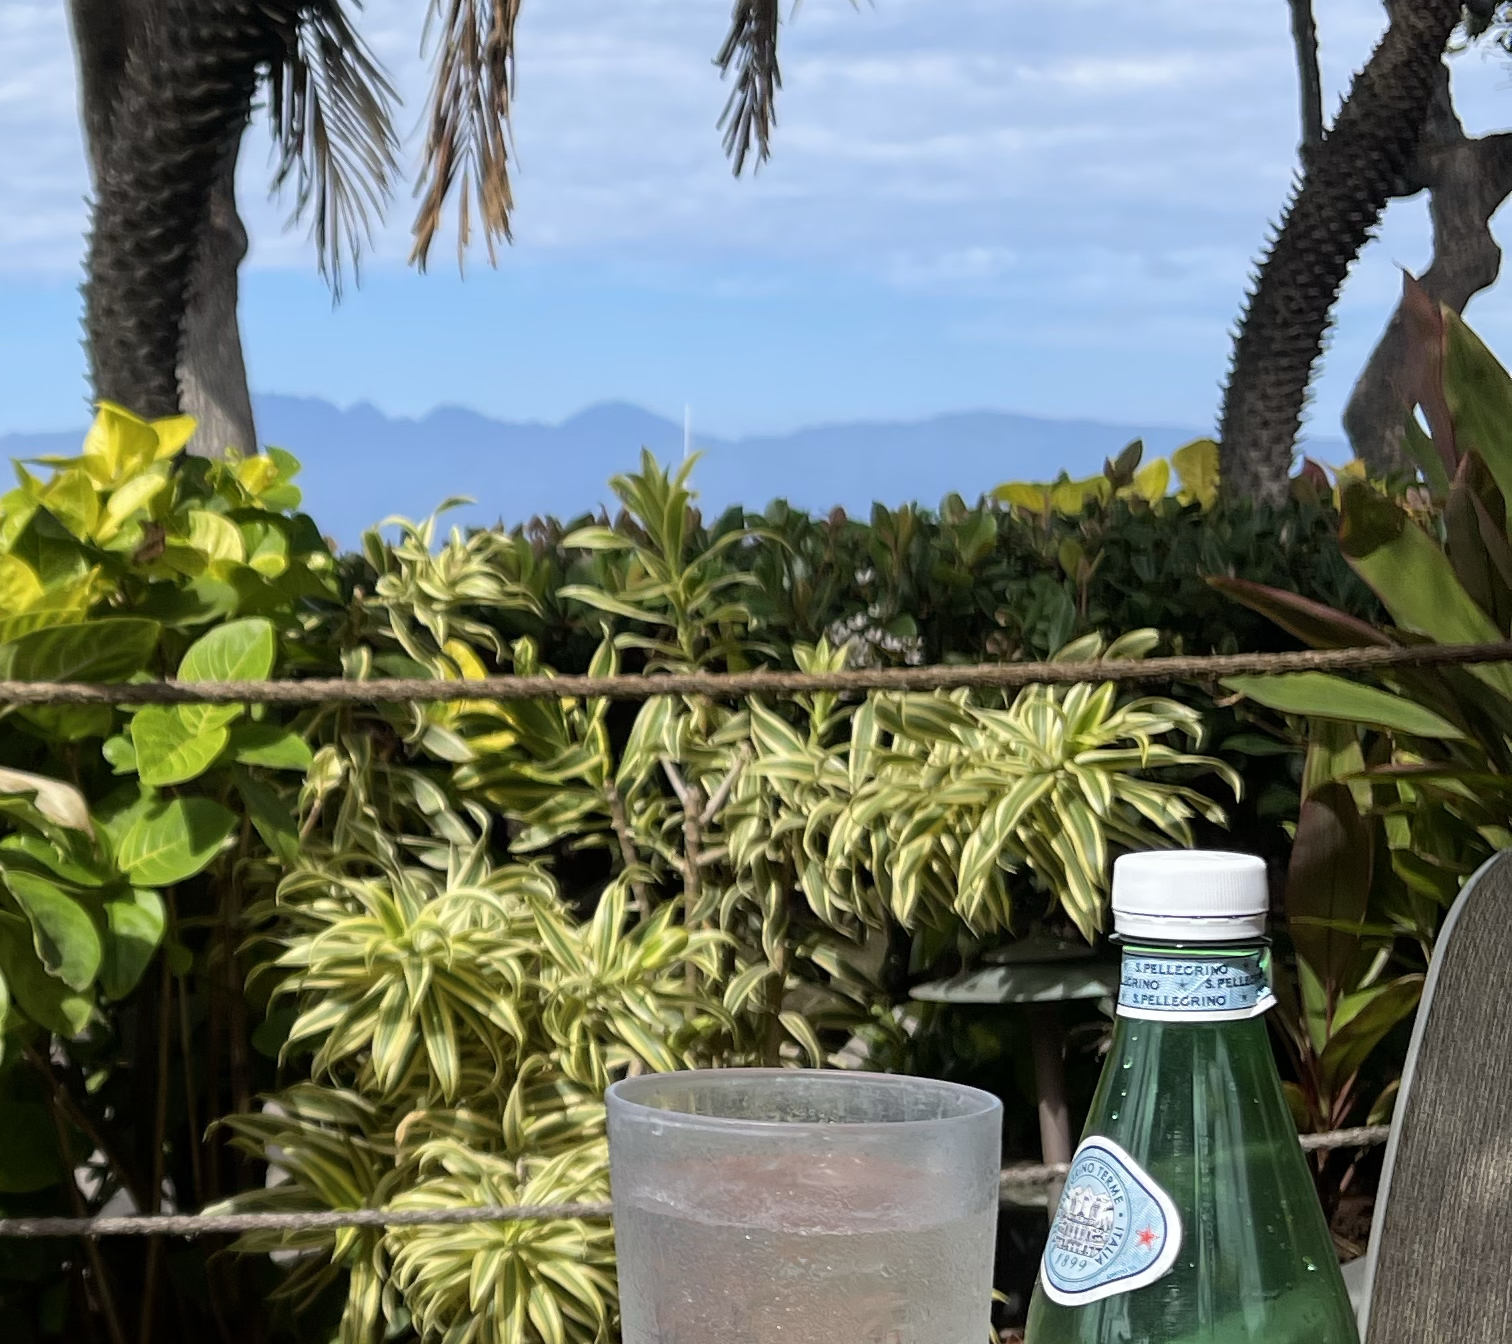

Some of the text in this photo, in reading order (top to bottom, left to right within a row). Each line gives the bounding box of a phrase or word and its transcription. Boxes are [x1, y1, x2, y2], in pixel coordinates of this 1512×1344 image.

[1098, 1166, 1125, 1205] TERME
[1054, 1253, 1088, 1272] 1899
[1094, 1227, 1125, 1266] ITALIA
